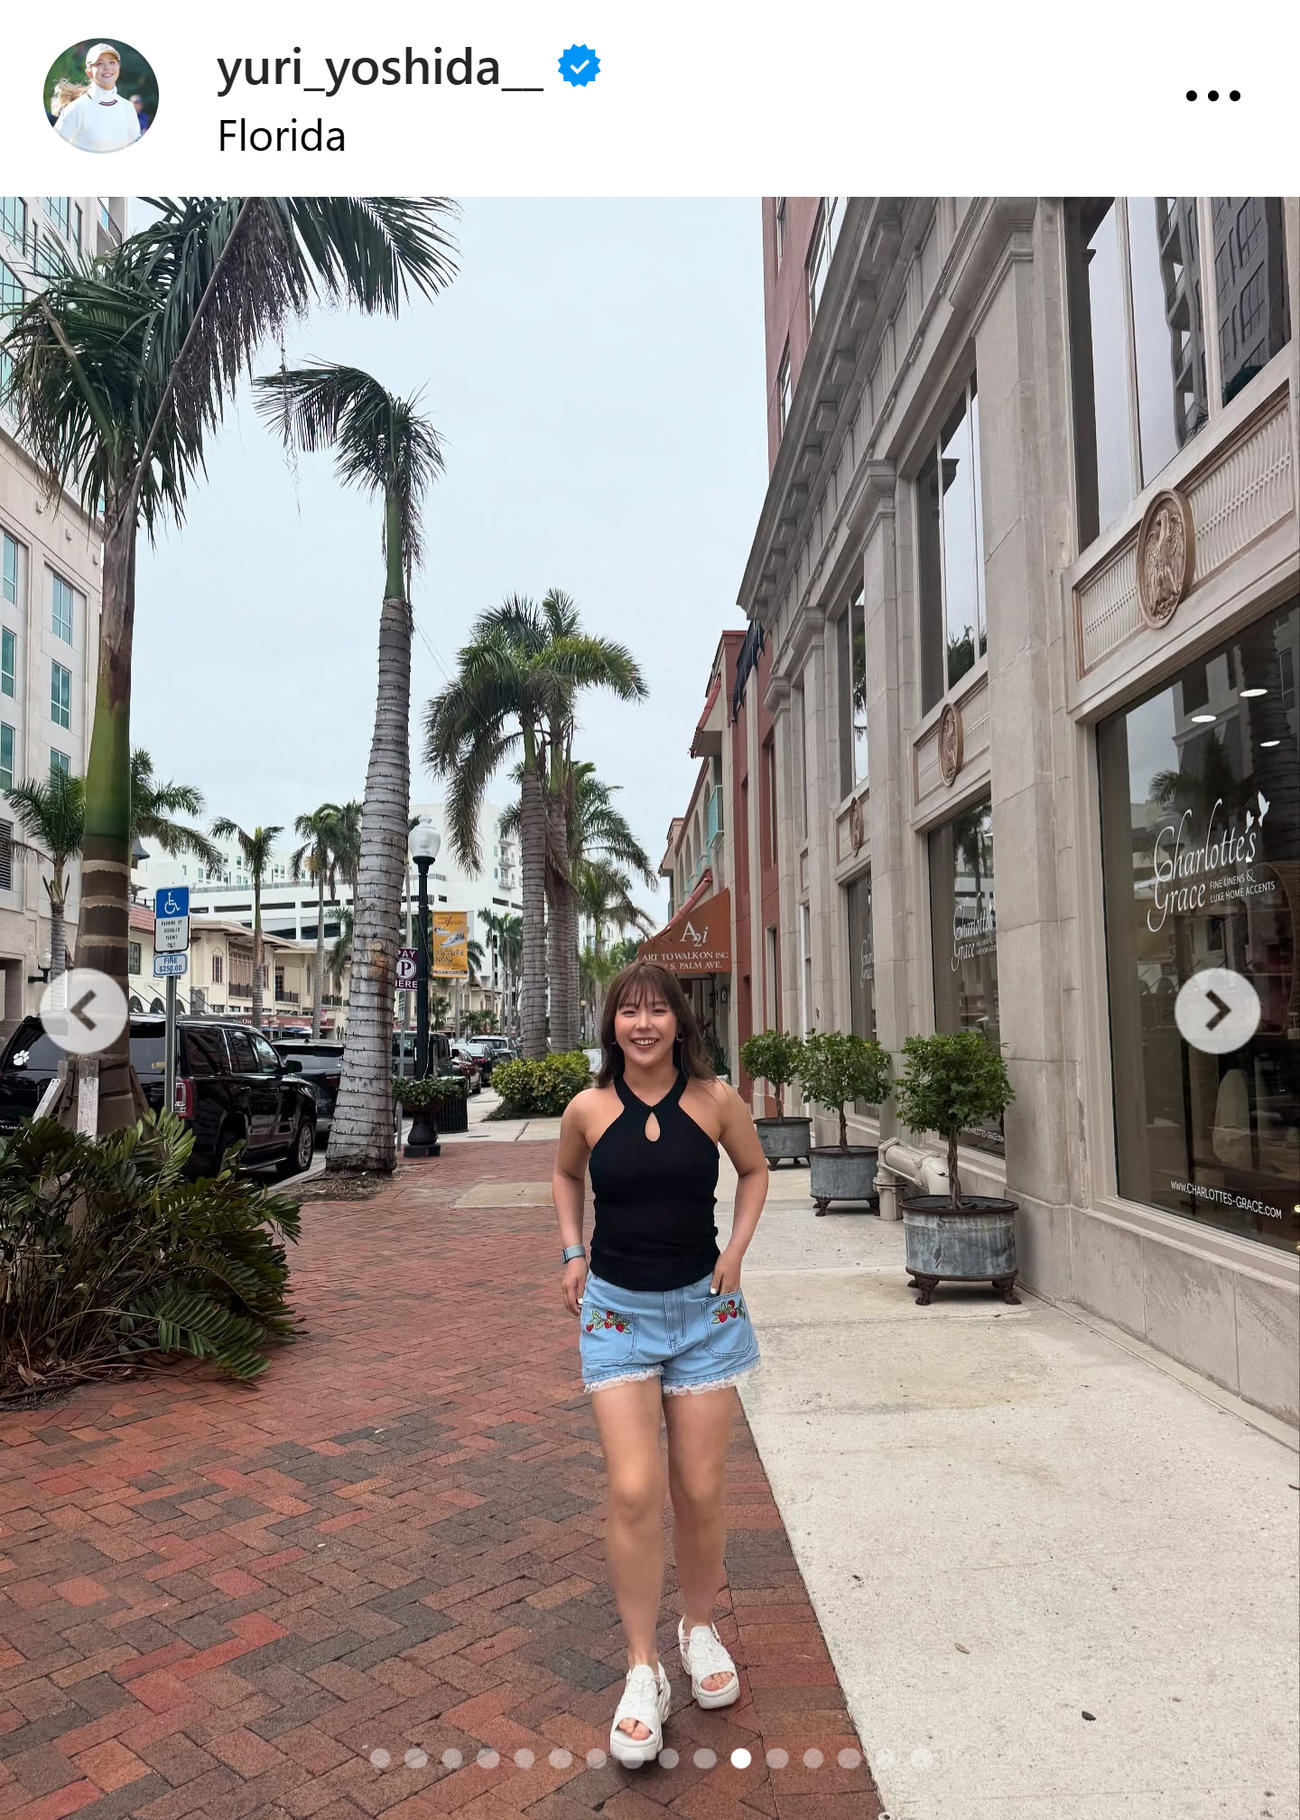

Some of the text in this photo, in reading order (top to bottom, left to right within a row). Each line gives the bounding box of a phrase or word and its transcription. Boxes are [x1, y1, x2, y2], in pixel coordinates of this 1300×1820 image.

[1154, 798, 1257, 883] Charlotte's
[1210, 868, 1256, 890] FINE LINENS &
[1210, 880, 1276, 904] LUXE HOME ACCENTS
[1147, 878, 1206, 932] Grace
[673, 951, 699, 960] WALK
[680, 961, 702, 970] PALM
